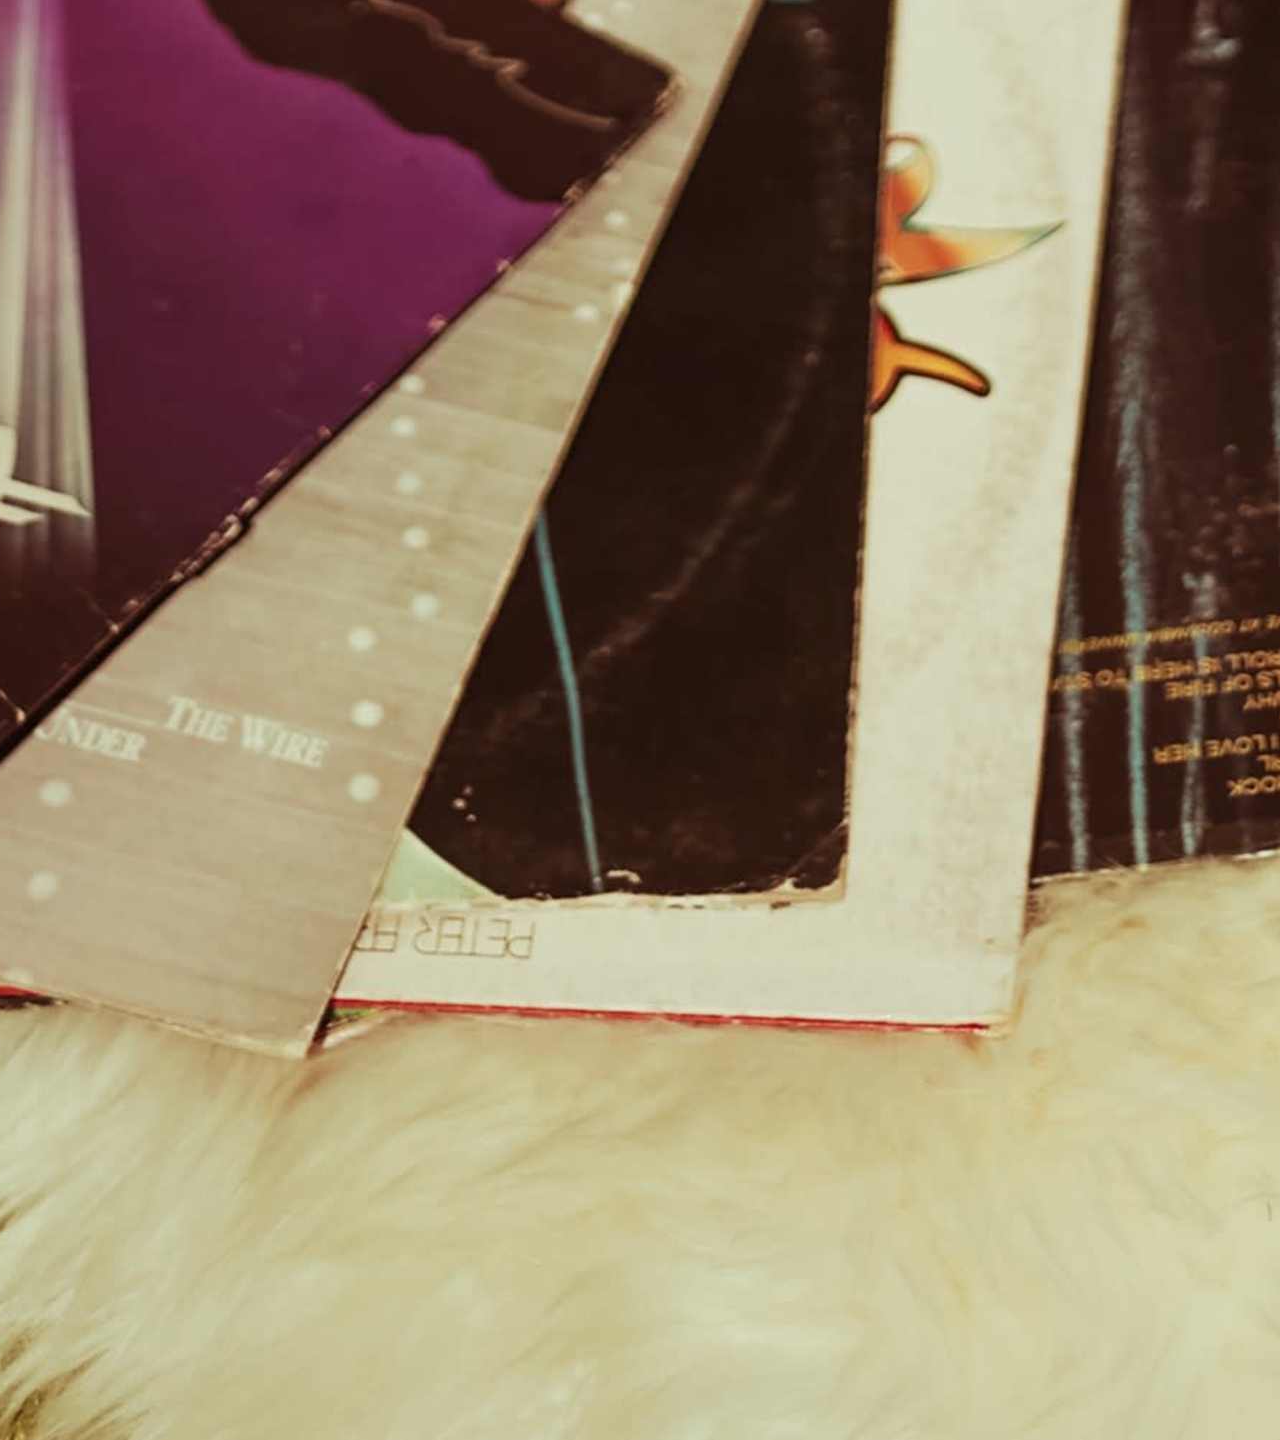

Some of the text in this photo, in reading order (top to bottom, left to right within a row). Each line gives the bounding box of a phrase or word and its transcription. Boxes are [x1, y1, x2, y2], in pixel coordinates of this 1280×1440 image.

[1133, 660, 1195, 682] HERE
[1198, 657, 1221, 675] IS
[1095, 669, 1128, 689] TO
[1221, 673, 1253, 694] OF
[1165, 680, 1216, 700] FIRE
[1153, 743, 1201, 764] HER
[1205, 734, 1266, 758] LOVE
[412, 915, 536, 960] PETER
